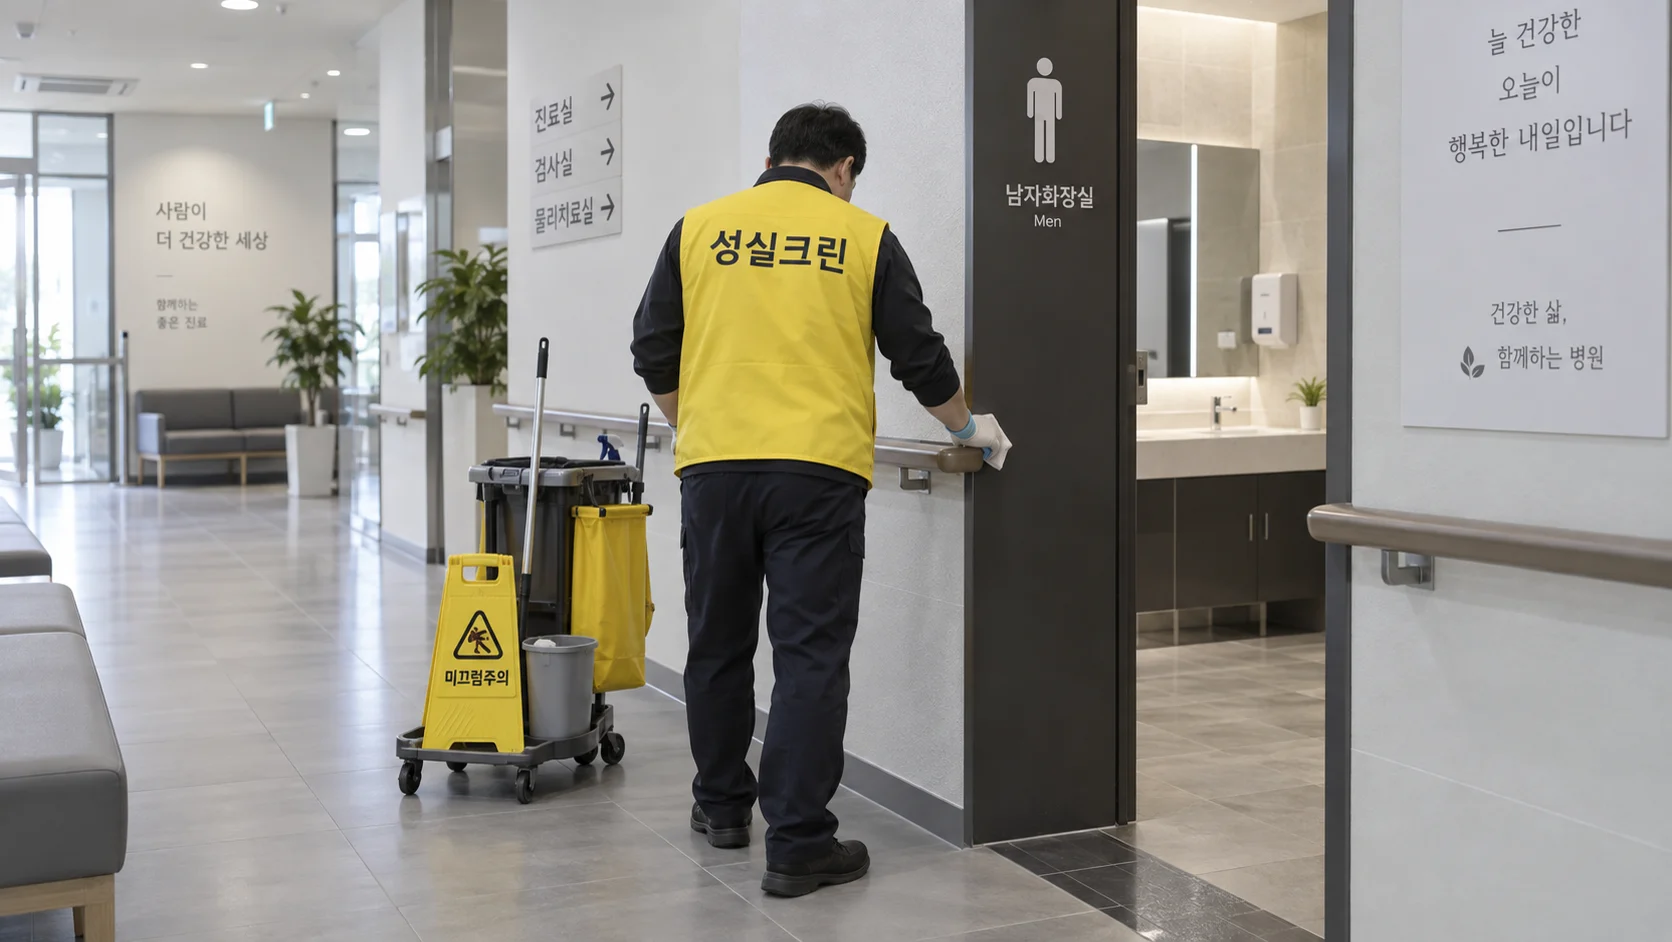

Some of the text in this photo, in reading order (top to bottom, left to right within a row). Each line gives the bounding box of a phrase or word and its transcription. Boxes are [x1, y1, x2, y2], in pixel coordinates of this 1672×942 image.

[1488, 9, 1581, 55] 늘 건강한
[1499, 65, 1559, 100] 오늘이
[535, 96, 572, 133] 진료실
[1449, 108, 1632, 163] 행복한 내일입니다
[535, 148, 572, 183] 검사실
[1006, 183, 1094, 209] 남자화장실
[156, 202, 205, 221] 사람이
[535, 197, 593, 234] 물리치료실
[1034, 214, 1062, 228] Men
[157, 231, 268, 251] 더 건강한 세상
[710, 230, 846, 274] 성실크린
[185, 316, 207, 329] 진료
[1491, 299, 1567, 325] 건강한 삶,
[1498, 345, 1603, 370] 함께하는 병원
[445, 670, 508, 686] 미끄럼주의
